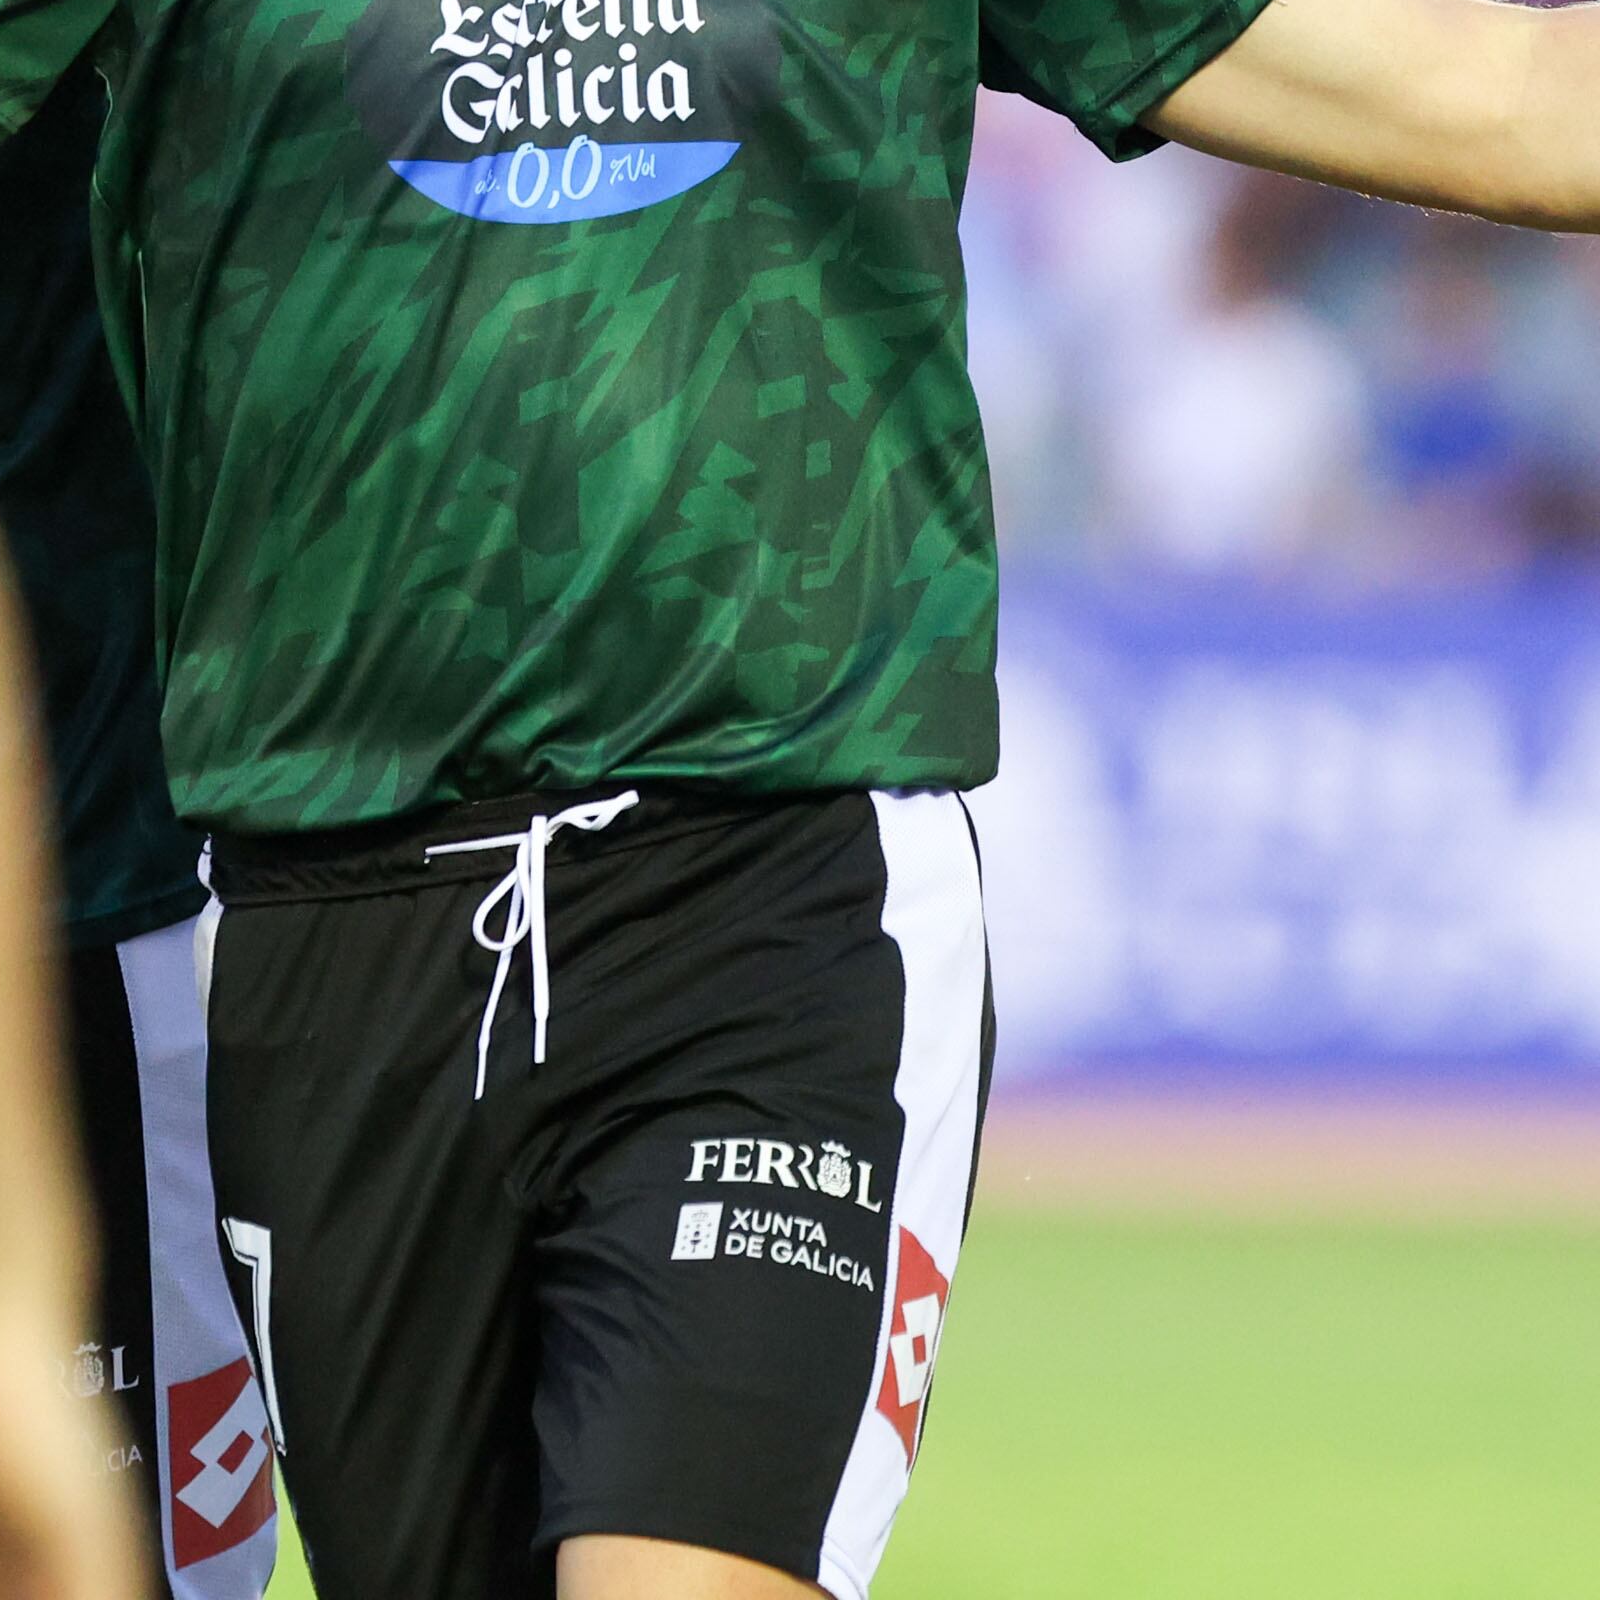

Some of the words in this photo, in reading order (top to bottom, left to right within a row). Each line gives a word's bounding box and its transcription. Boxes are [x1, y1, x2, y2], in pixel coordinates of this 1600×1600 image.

[441, 43, 696, 144] Galicia
[507, 134, 603, 209] 0,0
[684, 1137, 883, 1214] FERROL
[725, 1232, 765, 1258] DE
[770, 1241, 875, 1292] GALICIA
[730, 1207, 828, 1247] XUNTA
